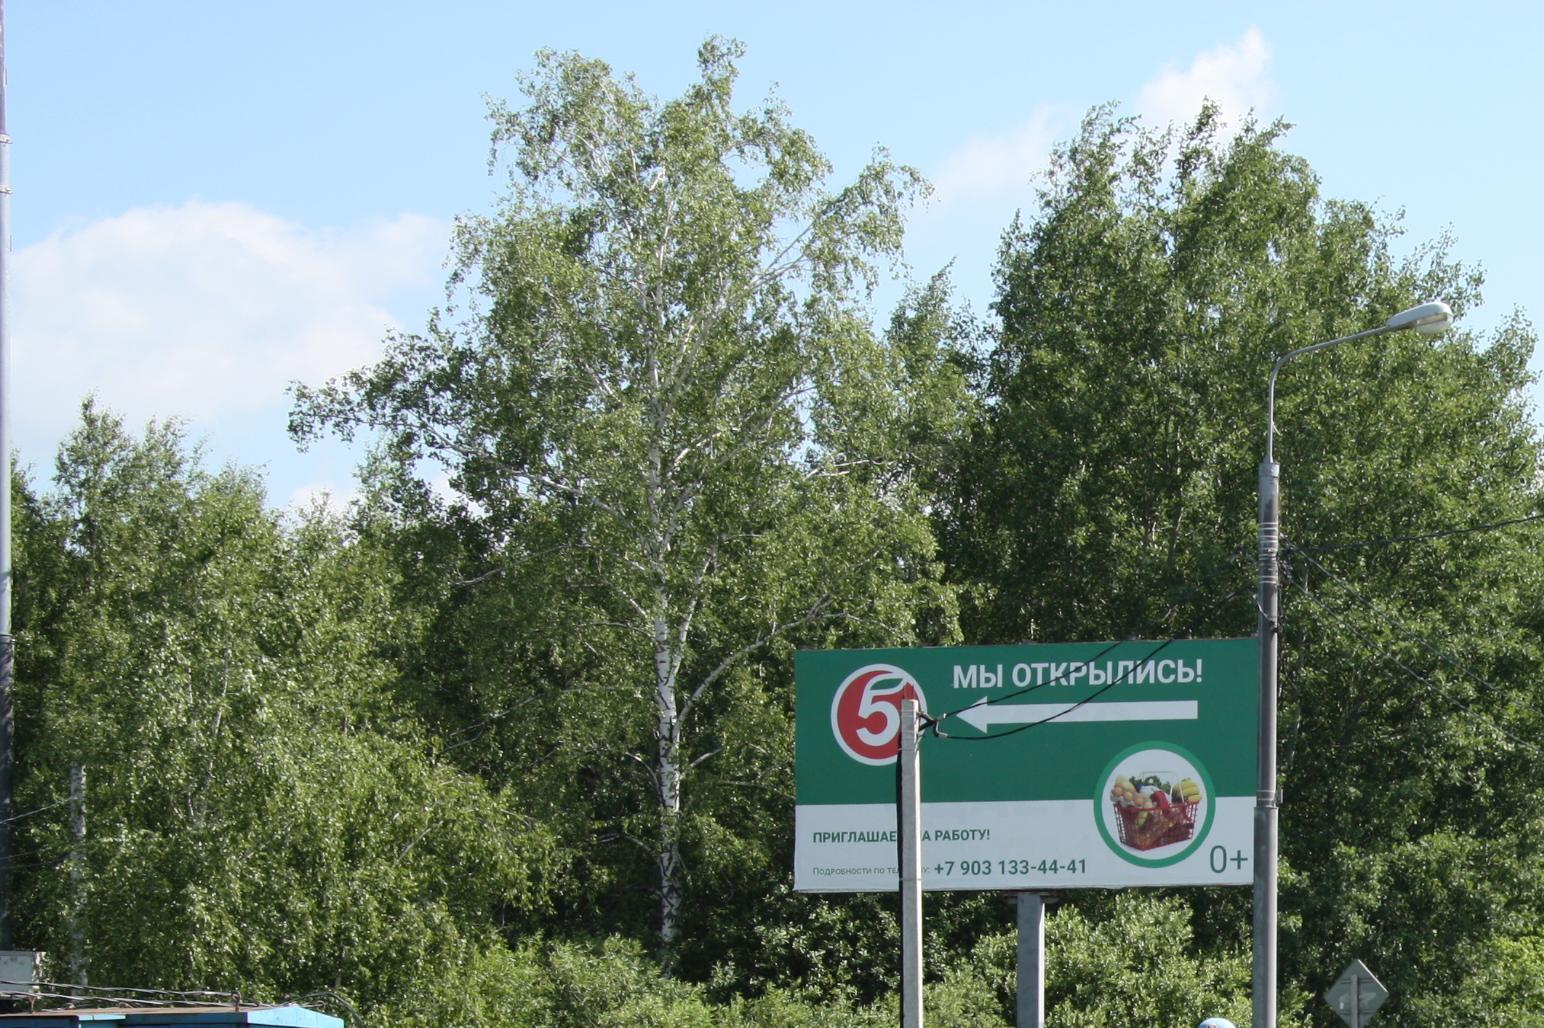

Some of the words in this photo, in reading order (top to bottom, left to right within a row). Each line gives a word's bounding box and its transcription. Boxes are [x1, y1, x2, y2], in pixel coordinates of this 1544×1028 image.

[953, 664, 1003, 689] МЫ
[1011, 658, 1203, 688] ОТКРЫЛИСЬ!
[856, 673, 906, 747] 5
[812, 831, 897, 843] ПРИГЛАШАЕ
[935, 829, 990, 842] РАБОТУ!
[934, 860, 955, 877] +7
[960, 860, 992, 876] 903
[998, 859, 1087, 875] 133-44-41
[1210, 845, 1249, 874] 0+
